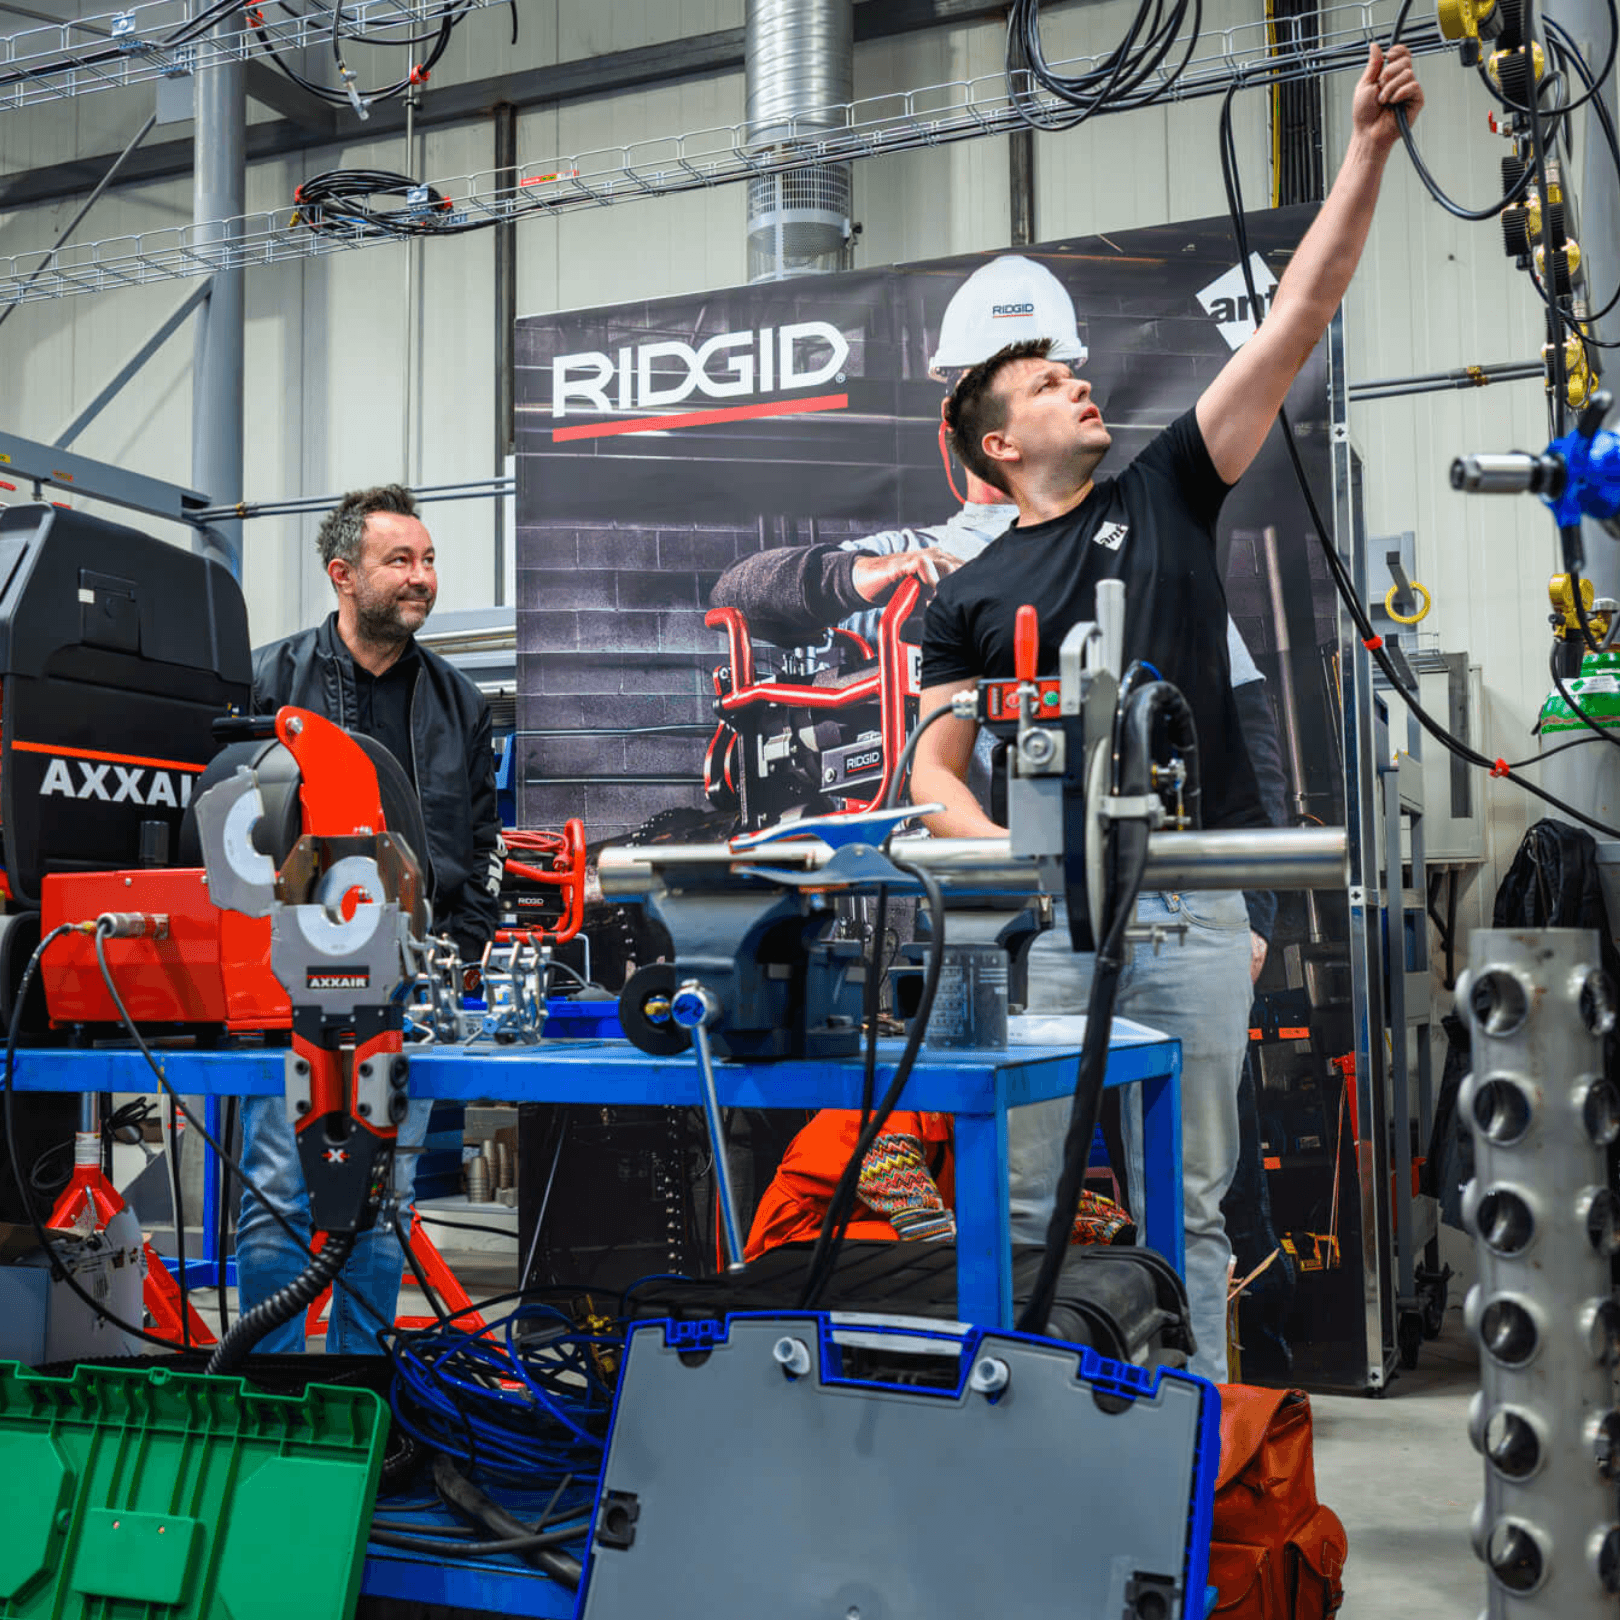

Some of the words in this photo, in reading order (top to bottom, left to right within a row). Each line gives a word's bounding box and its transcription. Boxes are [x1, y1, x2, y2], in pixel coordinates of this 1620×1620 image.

[992, 303, 1034, 315] RIDGID
[552, 321, 850, 418] RIDGID
[846, 752, 880, 770] RIDGID
[39, 758, 201, 809] AXXAI
[309, 978, 366, 988] AXXAIR
